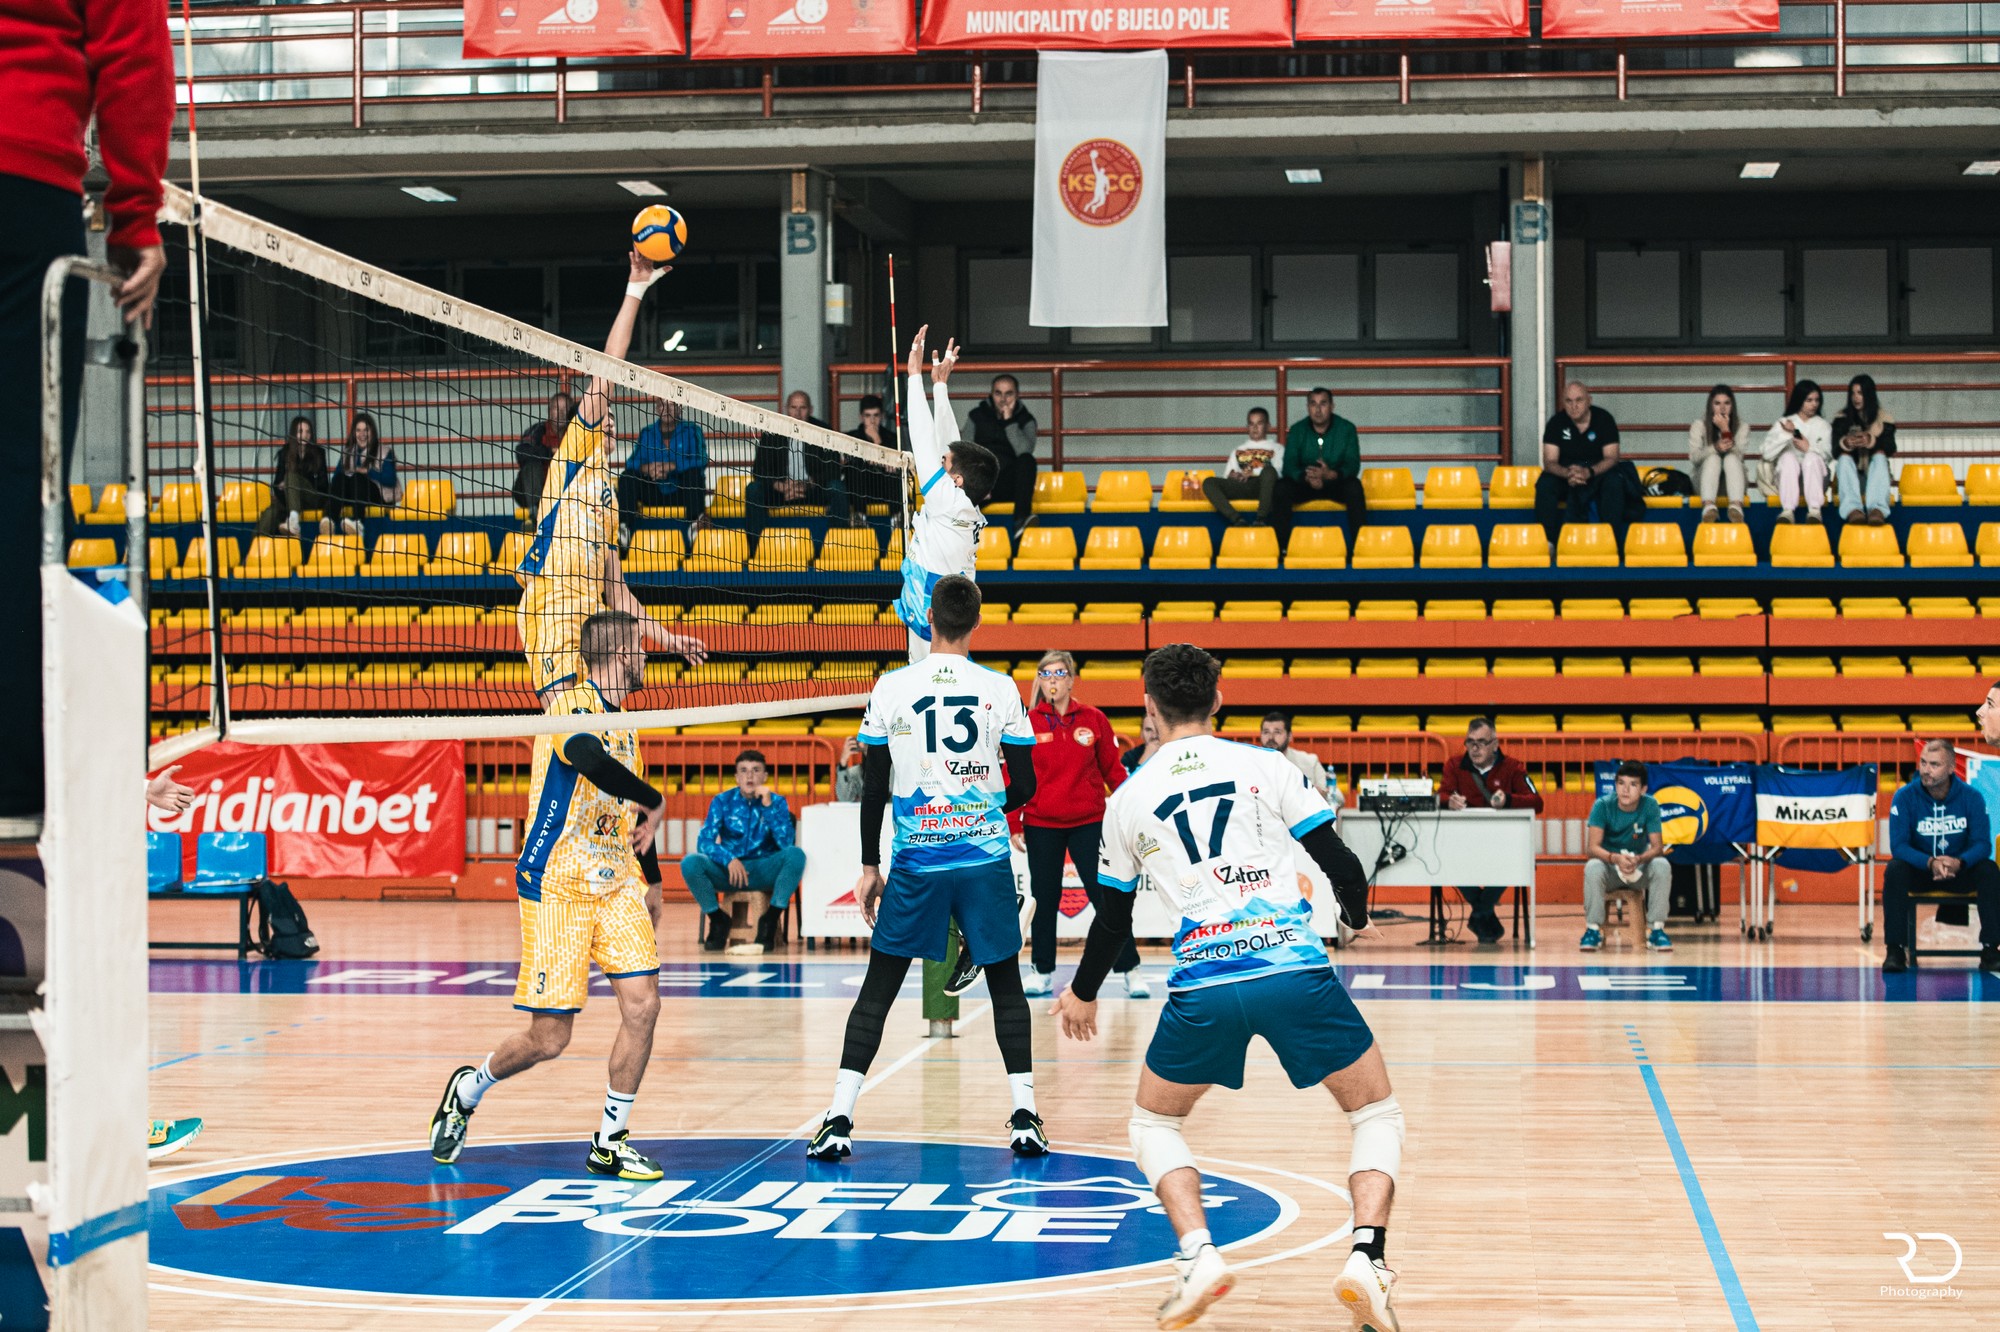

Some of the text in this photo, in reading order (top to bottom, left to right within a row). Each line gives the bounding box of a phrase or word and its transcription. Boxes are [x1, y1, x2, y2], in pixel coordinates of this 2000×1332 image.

[966, 7, 1230, 33] MUNICIPALITY OF BIJELO POLJE
[787, 215, 816, 254] B
[912, 696, 979, 753] 13
[949, 761, 989, 776] Zaton
[961, 773, 989, 786] petrol
[528, 799, 558, 864] SPORTIVO
[1153, 780, 1237, 865] 17
[1234, 928, 1297, 955] POLJE
[536, 972, 545, 994] 3
[492, 1178, 1152, 1213] BIJELO
[443, 1203, 1126, 1243] POLJE
